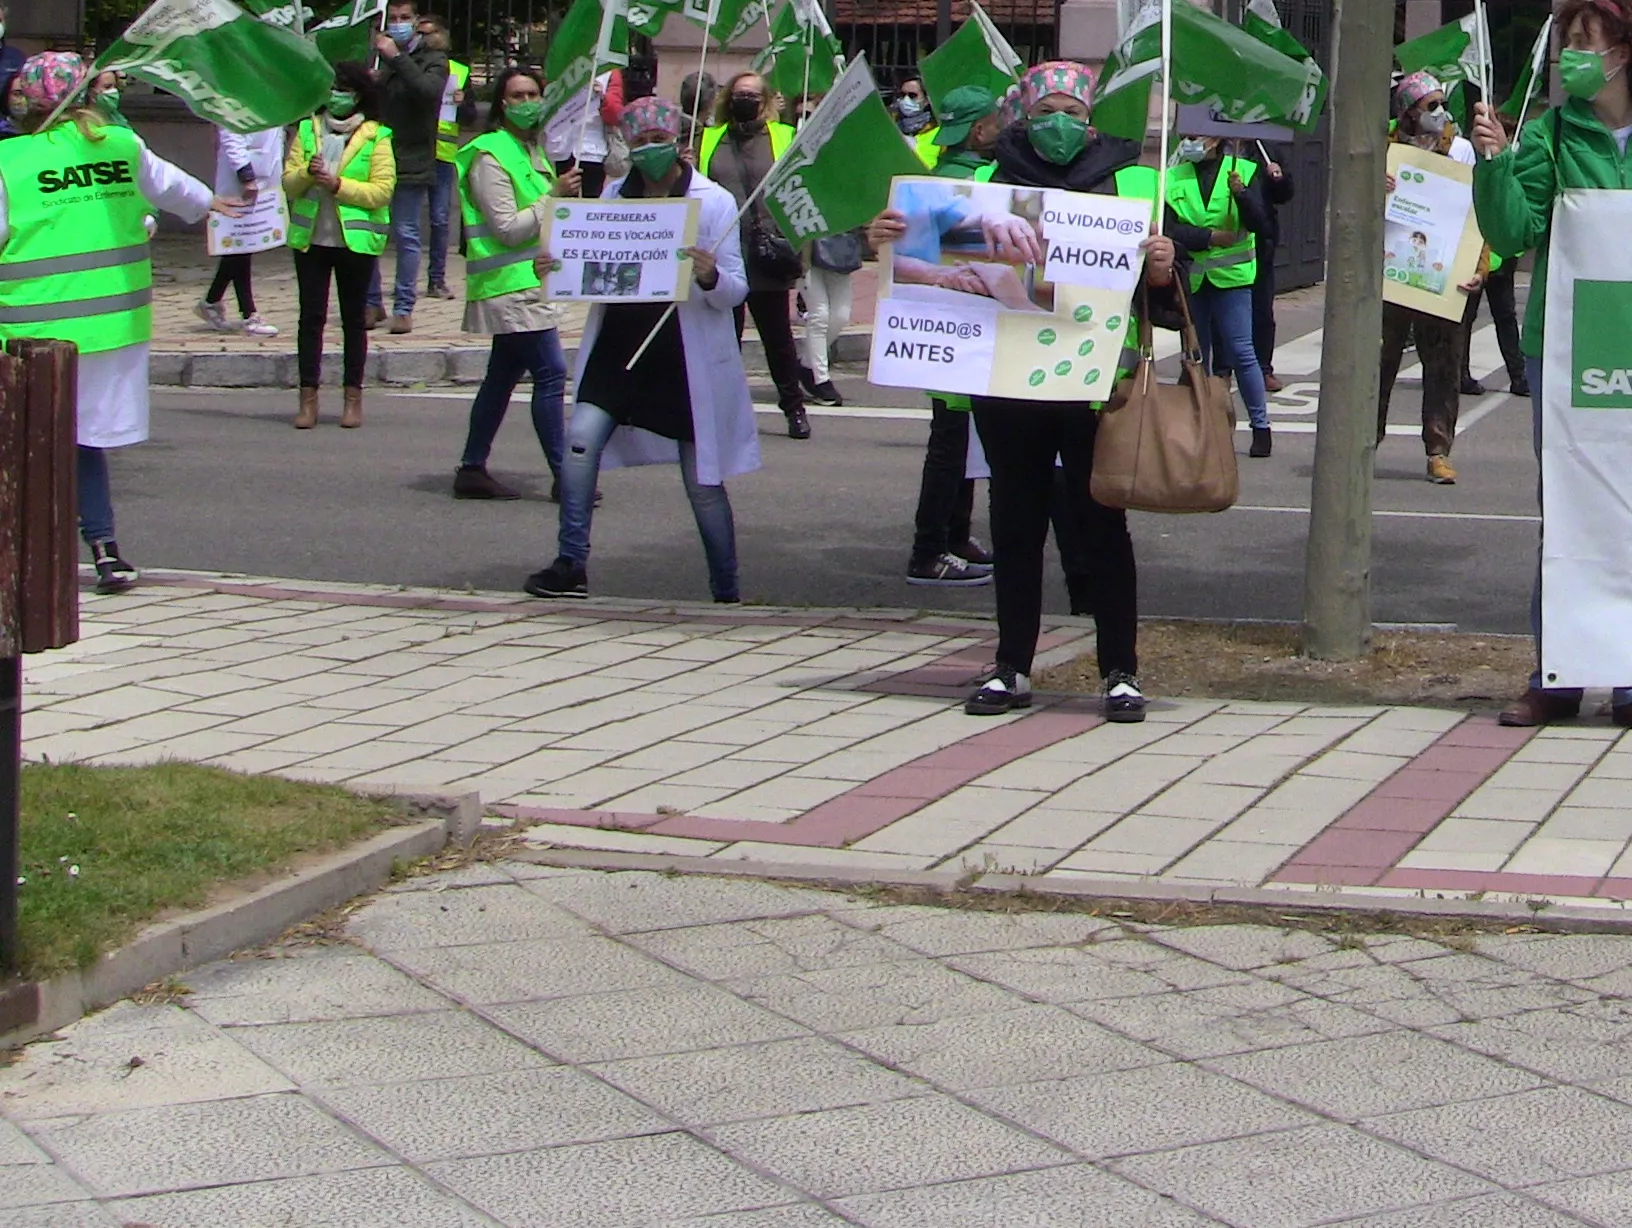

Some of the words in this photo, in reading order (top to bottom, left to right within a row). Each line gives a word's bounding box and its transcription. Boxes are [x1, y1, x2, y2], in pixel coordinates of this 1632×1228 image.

[38, 160, 133, 193] SATSE
[42, 196, 81, 209] Sindicato
[84, 194, 93, 202] de
[775, 174, 829, 238] SATSE
[586, 212, 657, 222] ENFERMERAS
[1044, 210, 1144, 234] OLVIDAD@S
[561, 229, 588, 239] ESTO
[591, 230, 605, 239] NO
[608, 231, 621, 240] ES
[624, 229, 675, 240] VOCACIÓN
[562, 248, 578, 259] ES
[582, 247, 668, 261] EXPLOTACIÓN
[1049, 245, 1131, 270] AHORA
[887, 316, 982, 339] OLVIDAD@S
[884, 341, 955, 363] ANTES
